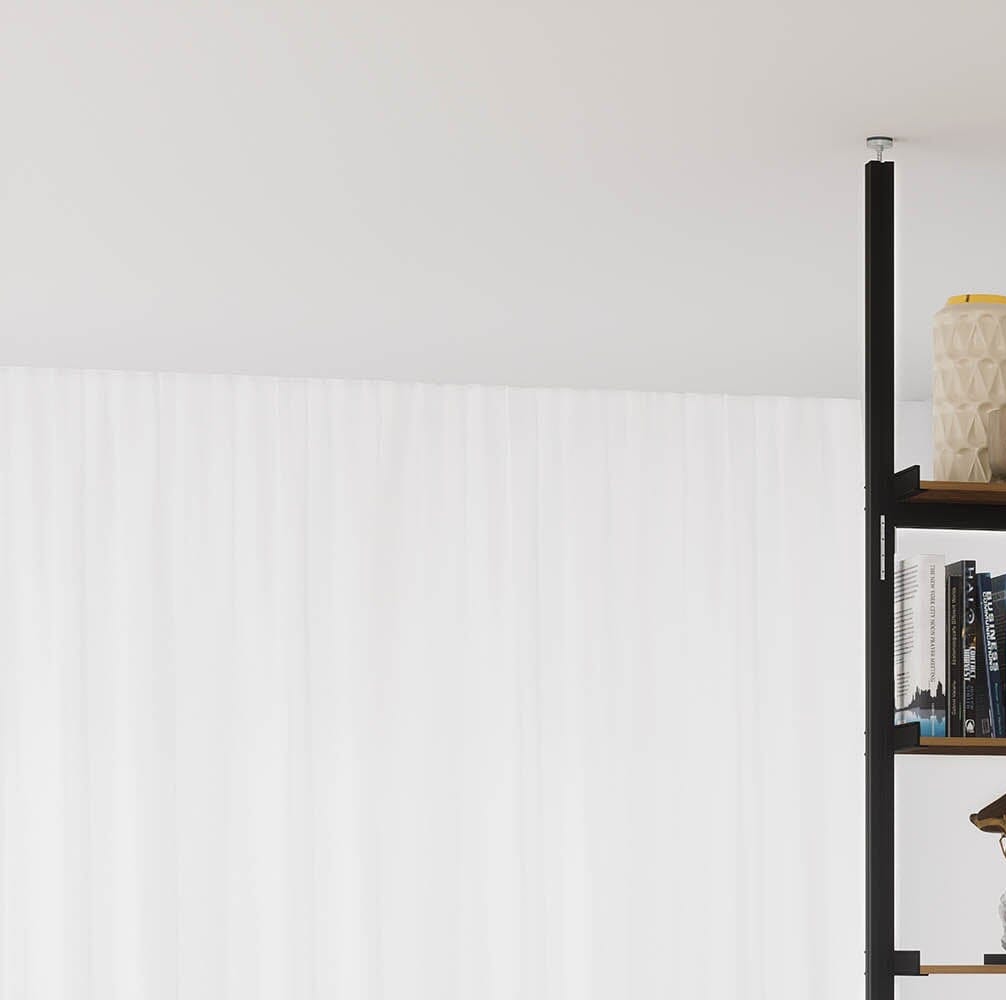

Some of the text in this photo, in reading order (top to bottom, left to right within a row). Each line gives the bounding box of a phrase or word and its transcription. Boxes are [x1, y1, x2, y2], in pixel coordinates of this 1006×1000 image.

[967, 567, 975, 624] HALO
[982, 591, 993, 672] COMMUNICATIONS
[987, 591, 999, 672] BUSINESS
